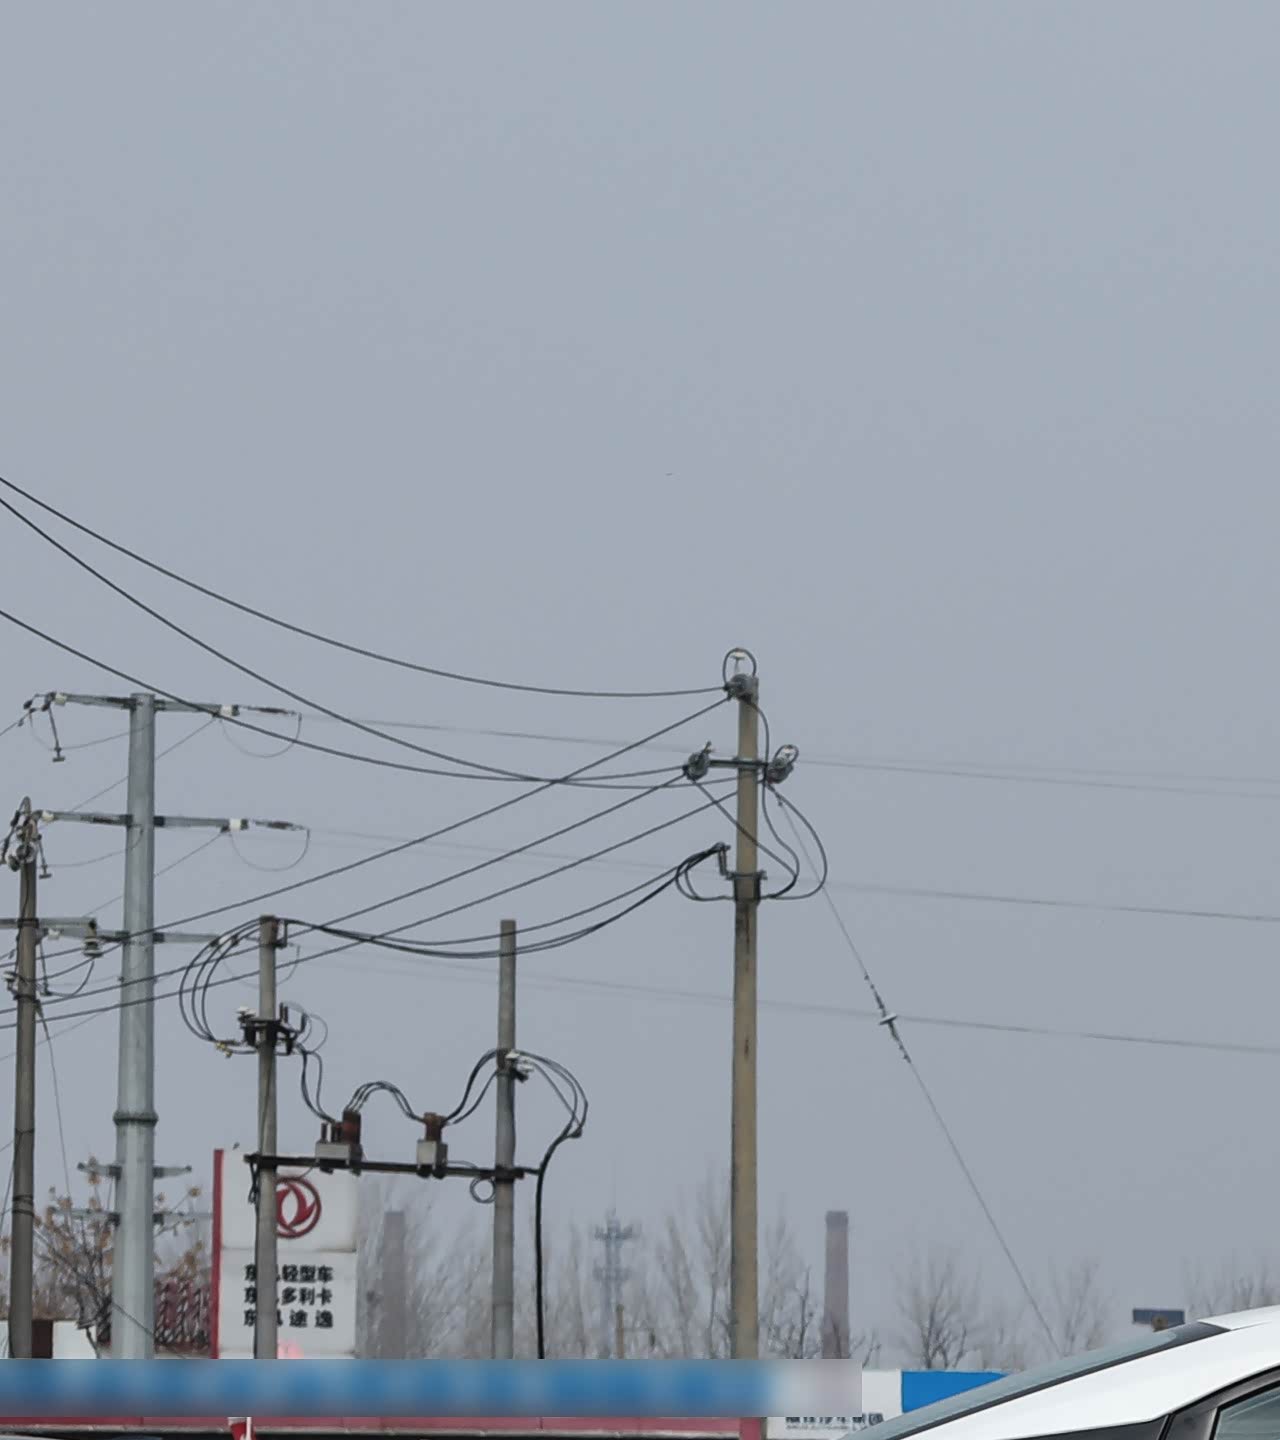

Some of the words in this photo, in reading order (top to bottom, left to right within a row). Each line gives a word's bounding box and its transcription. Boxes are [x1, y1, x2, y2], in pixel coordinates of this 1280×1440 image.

[244, 1263, 334, 1282] 东轻型车
[244, 1285, 333, 1306] 东多利卡
[243, 1308, 334, 1328] 东途逸
